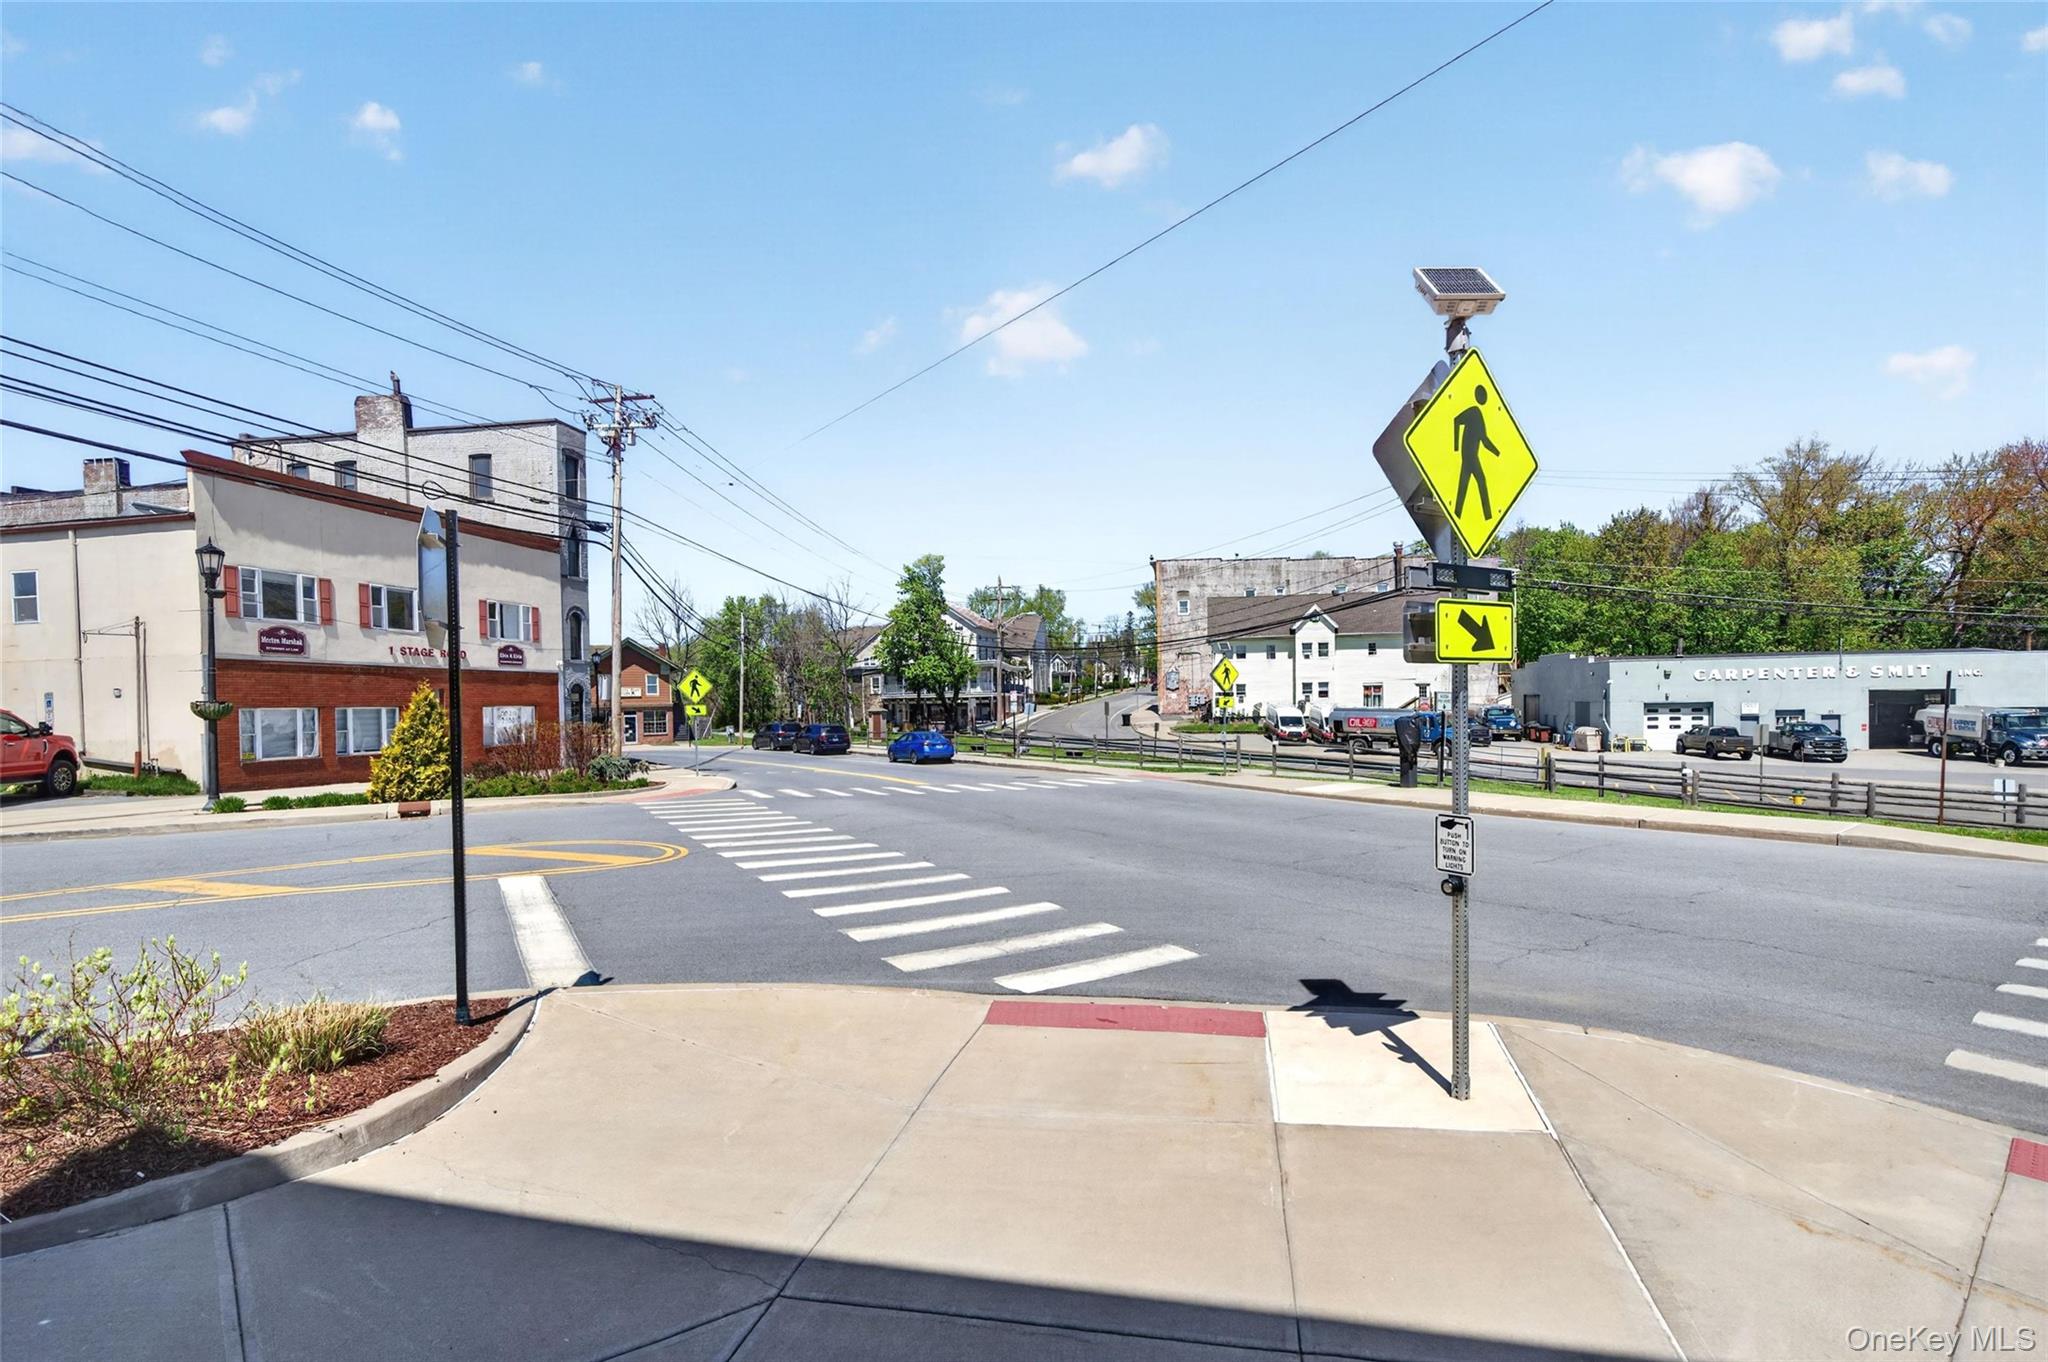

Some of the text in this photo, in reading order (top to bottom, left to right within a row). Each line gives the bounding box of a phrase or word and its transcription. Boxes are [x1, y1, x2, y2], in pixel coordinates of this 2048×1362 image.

[389, 646, 393, 655] 1
[400, 647, 435, 658] STAGE
[1693, 666, 1837, 681] CARPENTER
[1845, 665, 1861, 679] &
[1870, 664, 1931, 679] SMIT
[1448, 831, 1461, 839] PUSH
[1440, 838, 1459, 846] BUTTON
[1443, 846, 1456, 854] TURN
[1443, 854, 1466, 863] WARNING
[1445, 862, 1463, 870] LIGHTS
